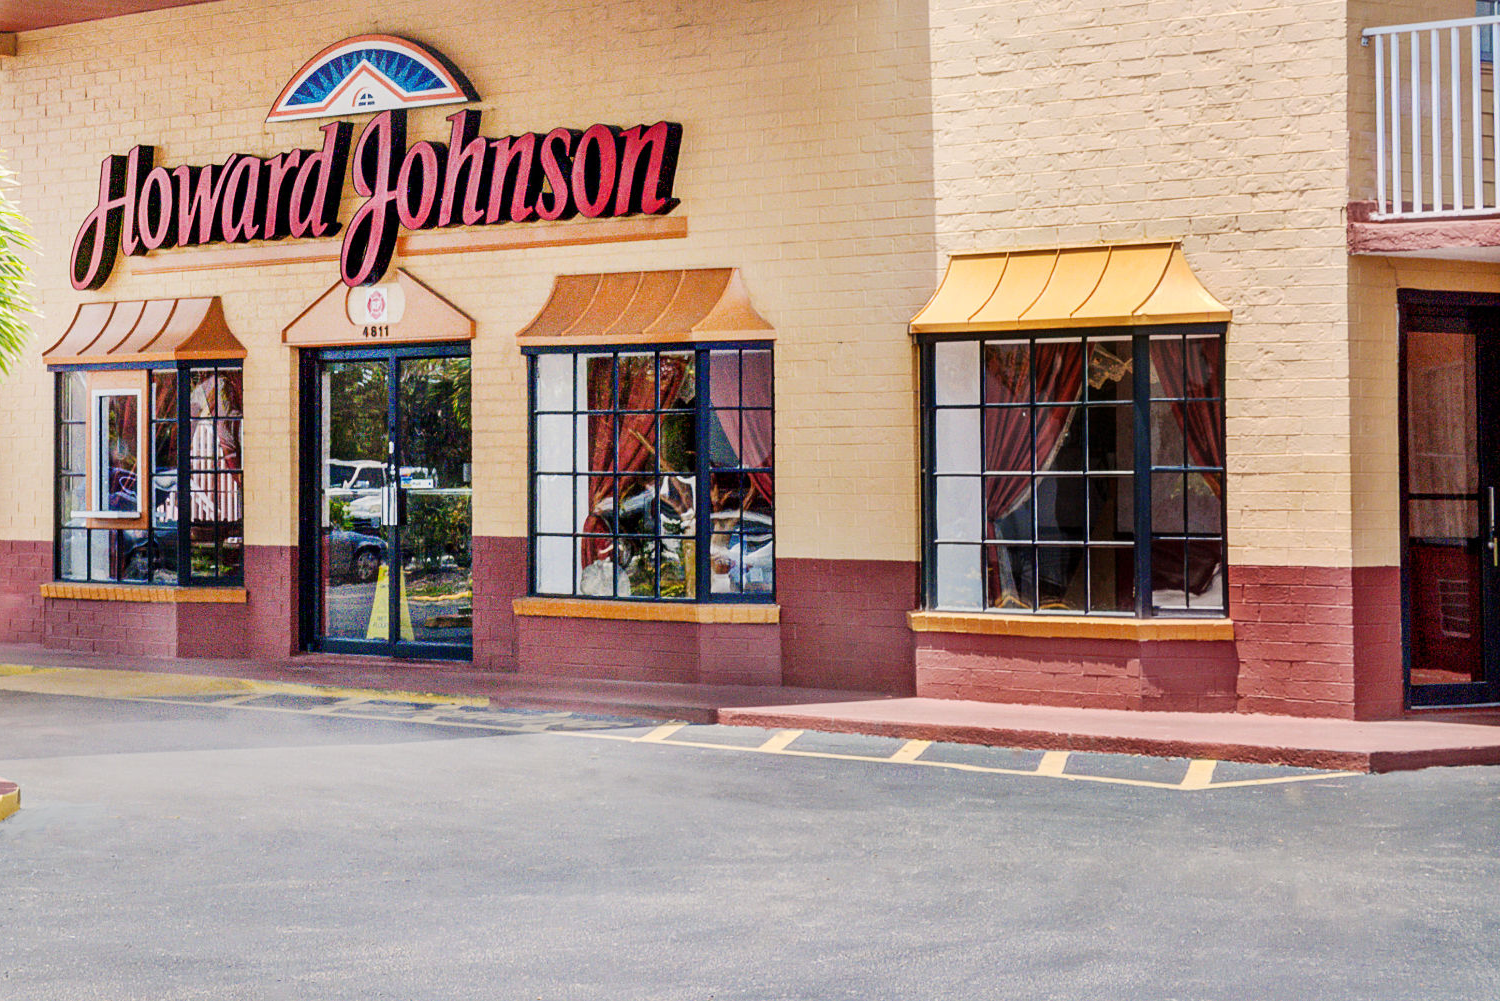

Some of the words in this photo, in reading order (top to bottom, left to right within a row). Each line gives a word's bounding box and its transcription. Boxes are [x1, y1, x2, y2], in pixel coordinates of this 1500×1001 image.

[70, 121, 354, 290] Howard
[340, 109, 683, 287] Johnson
[363, 325, 389, 338] 4811
